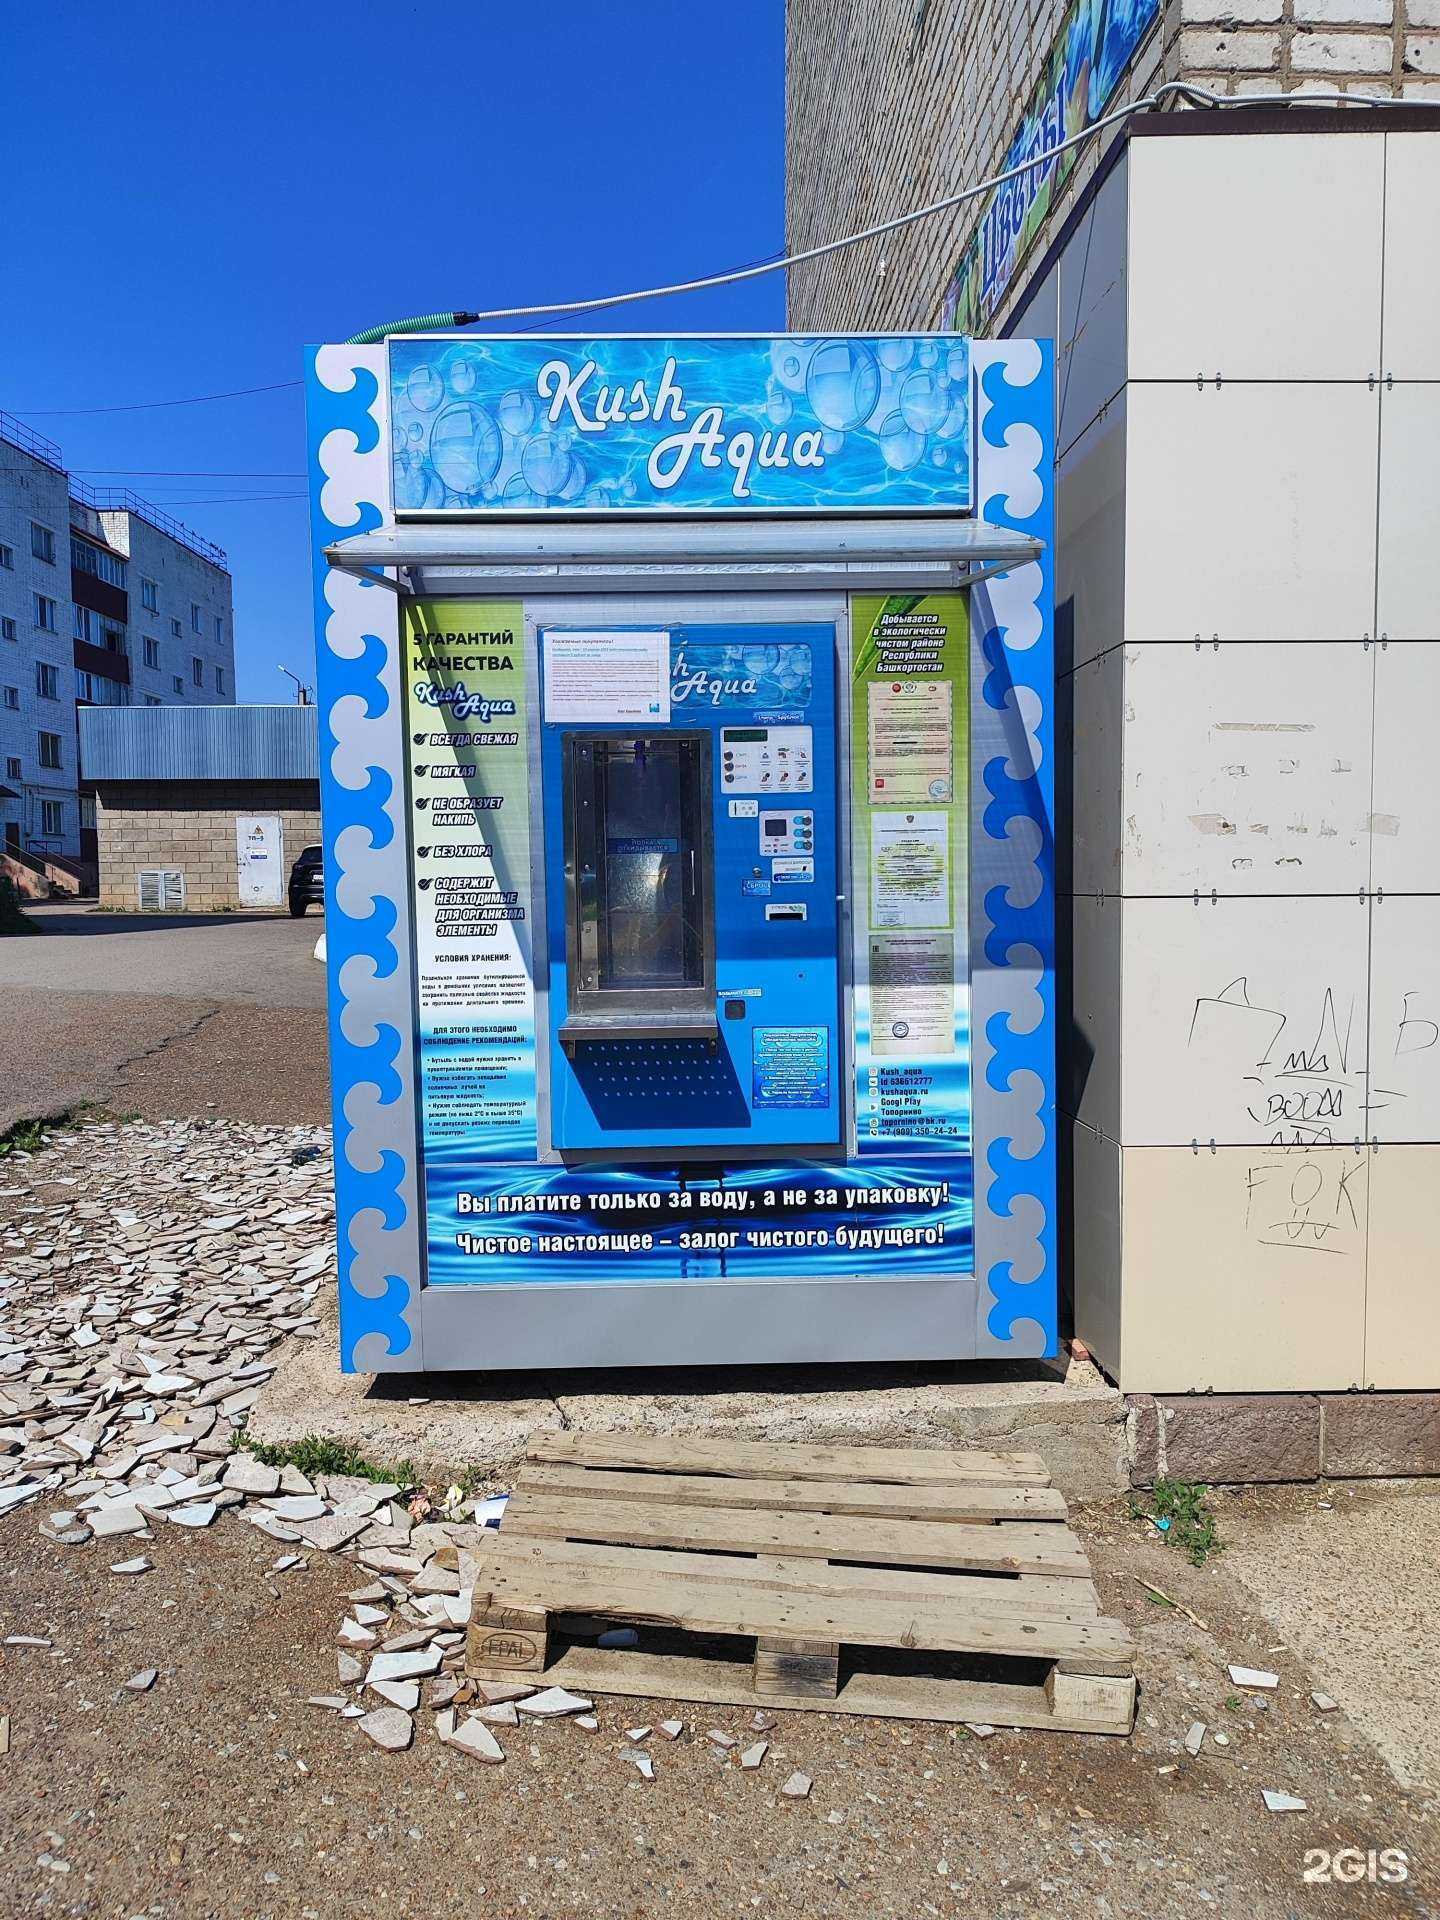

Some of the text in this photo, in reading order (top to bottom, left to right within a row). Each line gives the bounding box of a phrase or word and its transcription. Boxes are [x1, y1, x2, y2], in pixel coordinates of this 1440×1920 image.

[536, 357, 687, 433] Kush
[646, 406, 825, 498] Aqua
[881, 615, 938, 624] Добывается
[881, 626, 946, 636] экологически
[413, 629, 514, 646] 5 ГАРАНТИЙ
[876, 637, 945, 649] чистом районе
[882, 651, 938, 661] Республики
[413, 656, 514, 671] КАЧЕСТВА
[876, 663, 943, 674] Башкортостан
[414, 681, 467, 706] Kush
[670, 671, 757, 704] Aqua
[453, 692, 516, 723] Aqua
[430, 732, 518, 746] ВСЕГДА СВЕЖАЯ
[431, 765, 476, 778] МЯГКАЯ
[432, 797, 503, 809] НЕ ОБРАЗУЕТ
[433, 814, 475, 826] НАКИПЬ
[434, 845, 492, 857] БЕЗ ХЛОРА
[435, 877, 493, 889] СОДЕРЖИТ
[435, 892, 517, 905] НЕОБХОДИМЫЕ
[435, 908, 524, 923] ДЛЯ ОРГАНИЗМА
[436, 925, 497, 937] ЭЛЕМЕНТЫ
[434, 953, 512, 963] УСЛОВИЯ ХРАНЕНИЯ:
[433, 1025, 518, 1035] ДЛЯ ЭТОГО НЕОБХОДИМО
[880, 1088, 928, 1096] kushaqua.ru
[457, 1183, 950, 1214] Вы платите только за воду, а не за упаковку!
[456, 1232, 532, 1254] Чистое
[538, 1233, 653, 1253] настоящее
[679, 1231, 740, 1249] залог
[747, 1229, 829, 1249] чистого
[835, 1223, 945, 1251] будущего!
